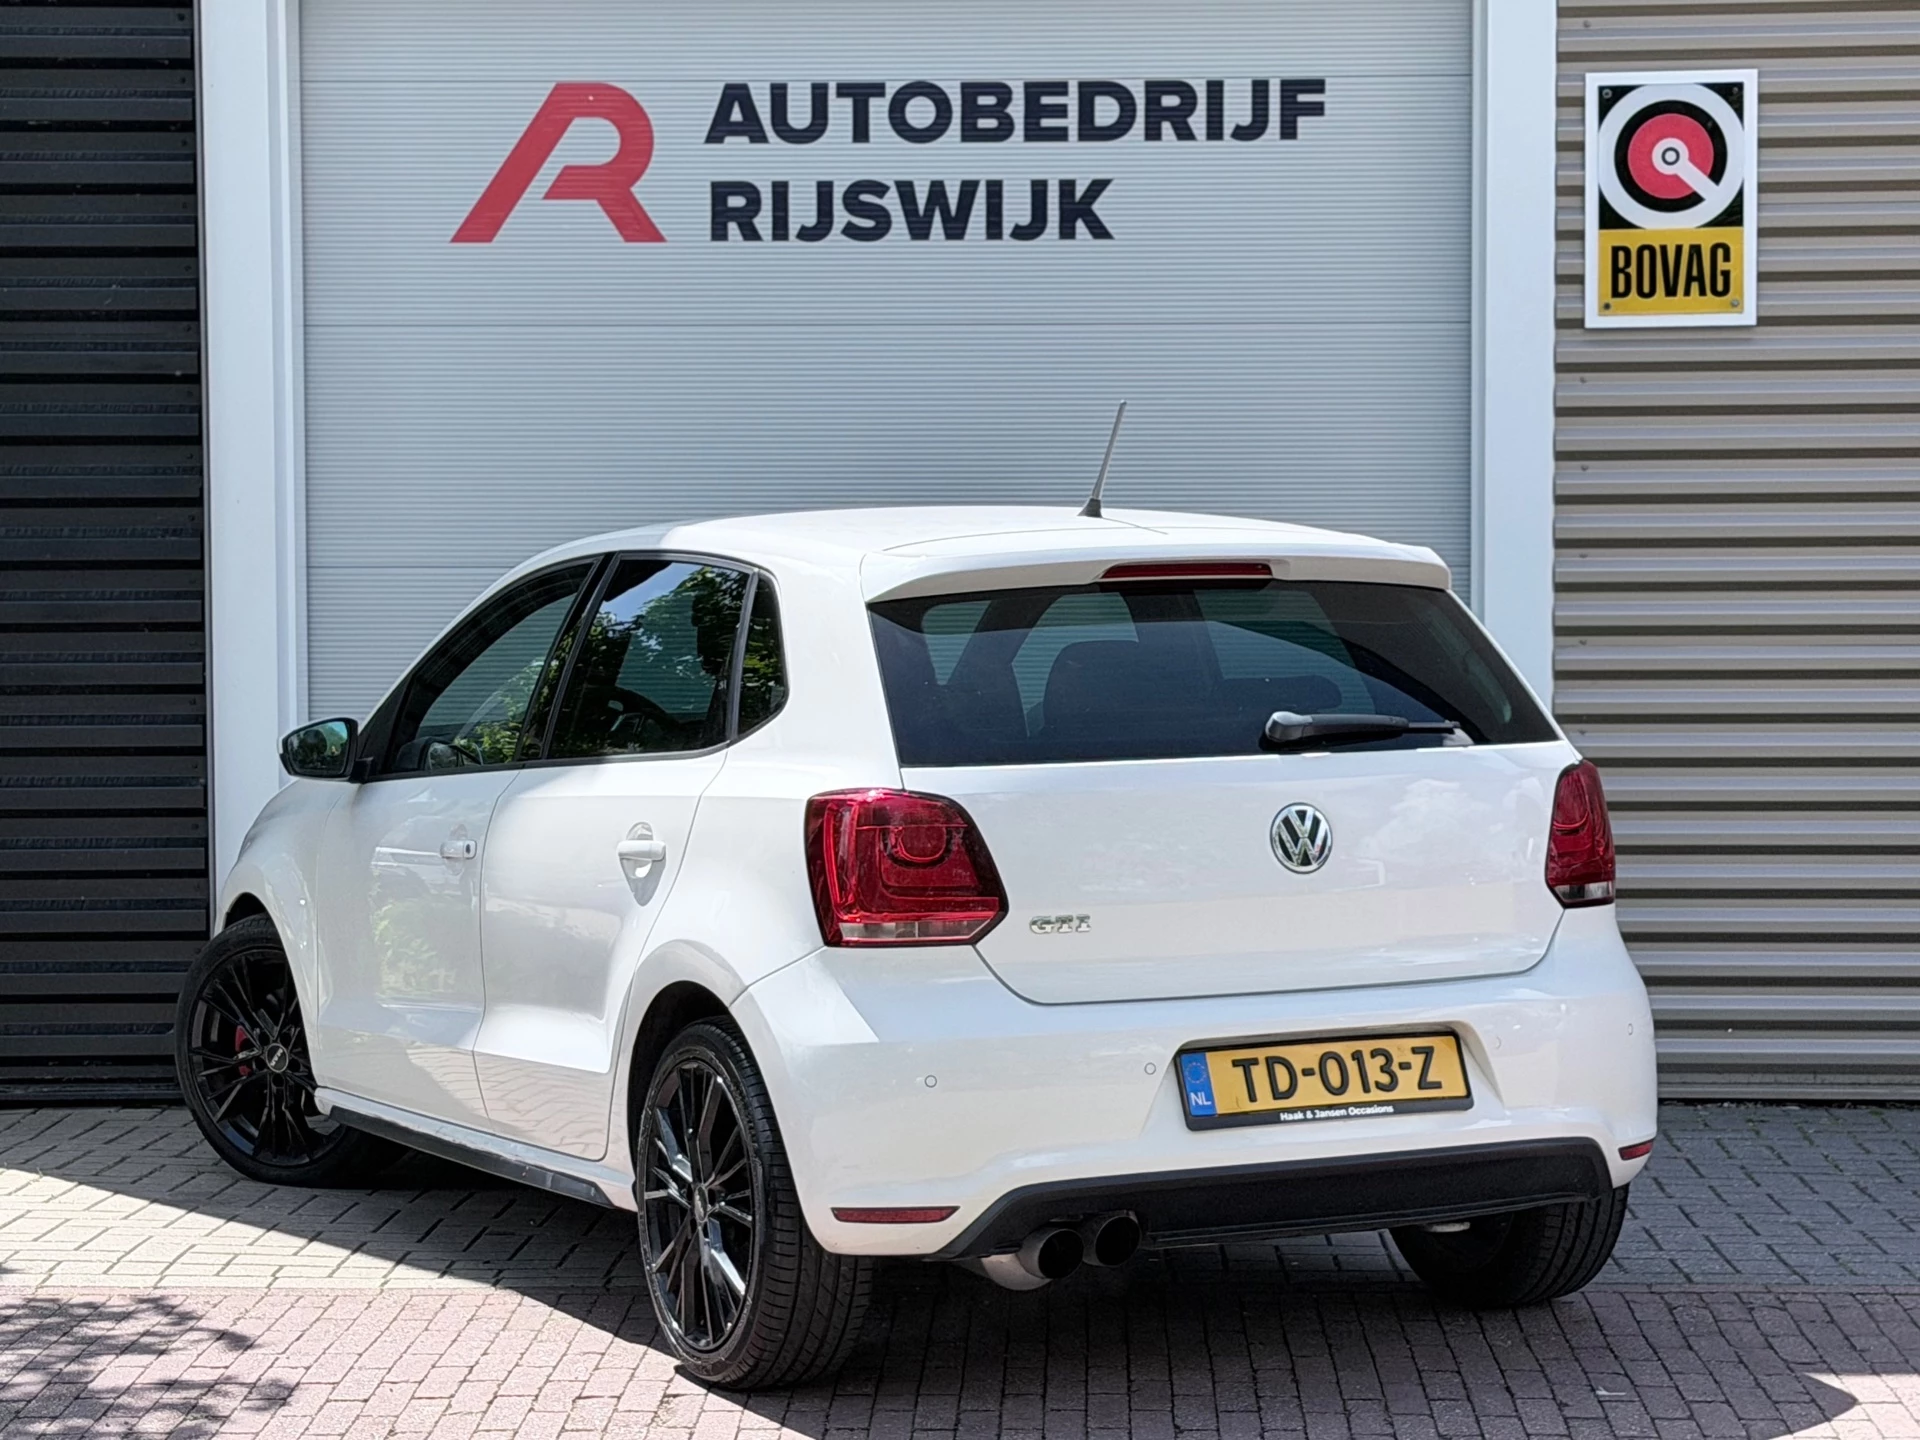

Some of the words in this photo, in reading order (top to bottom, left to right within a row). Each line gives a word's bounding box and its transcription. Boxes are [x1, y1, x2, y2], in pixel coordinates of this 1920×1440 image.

[704, 79, 1326, 144] AUTOBEDRIJF
[709, 179, 1115, 242] RIJSWIJK
[1611, 242, 1731, 298] BOVAG
[1029, 914, 1092, 934] GTI
[1190, 1092, 1212, 1105] NL
[1232, 1046, 1443, 1103] TD-013-Z
[1279, 1111, 1304, 1121] Haak
[1305, 1110, 1313, 1119] &
[1314, 1108, 1347, 1118] Jansen
[1348, 1104, 1394, 1116] Occasions
